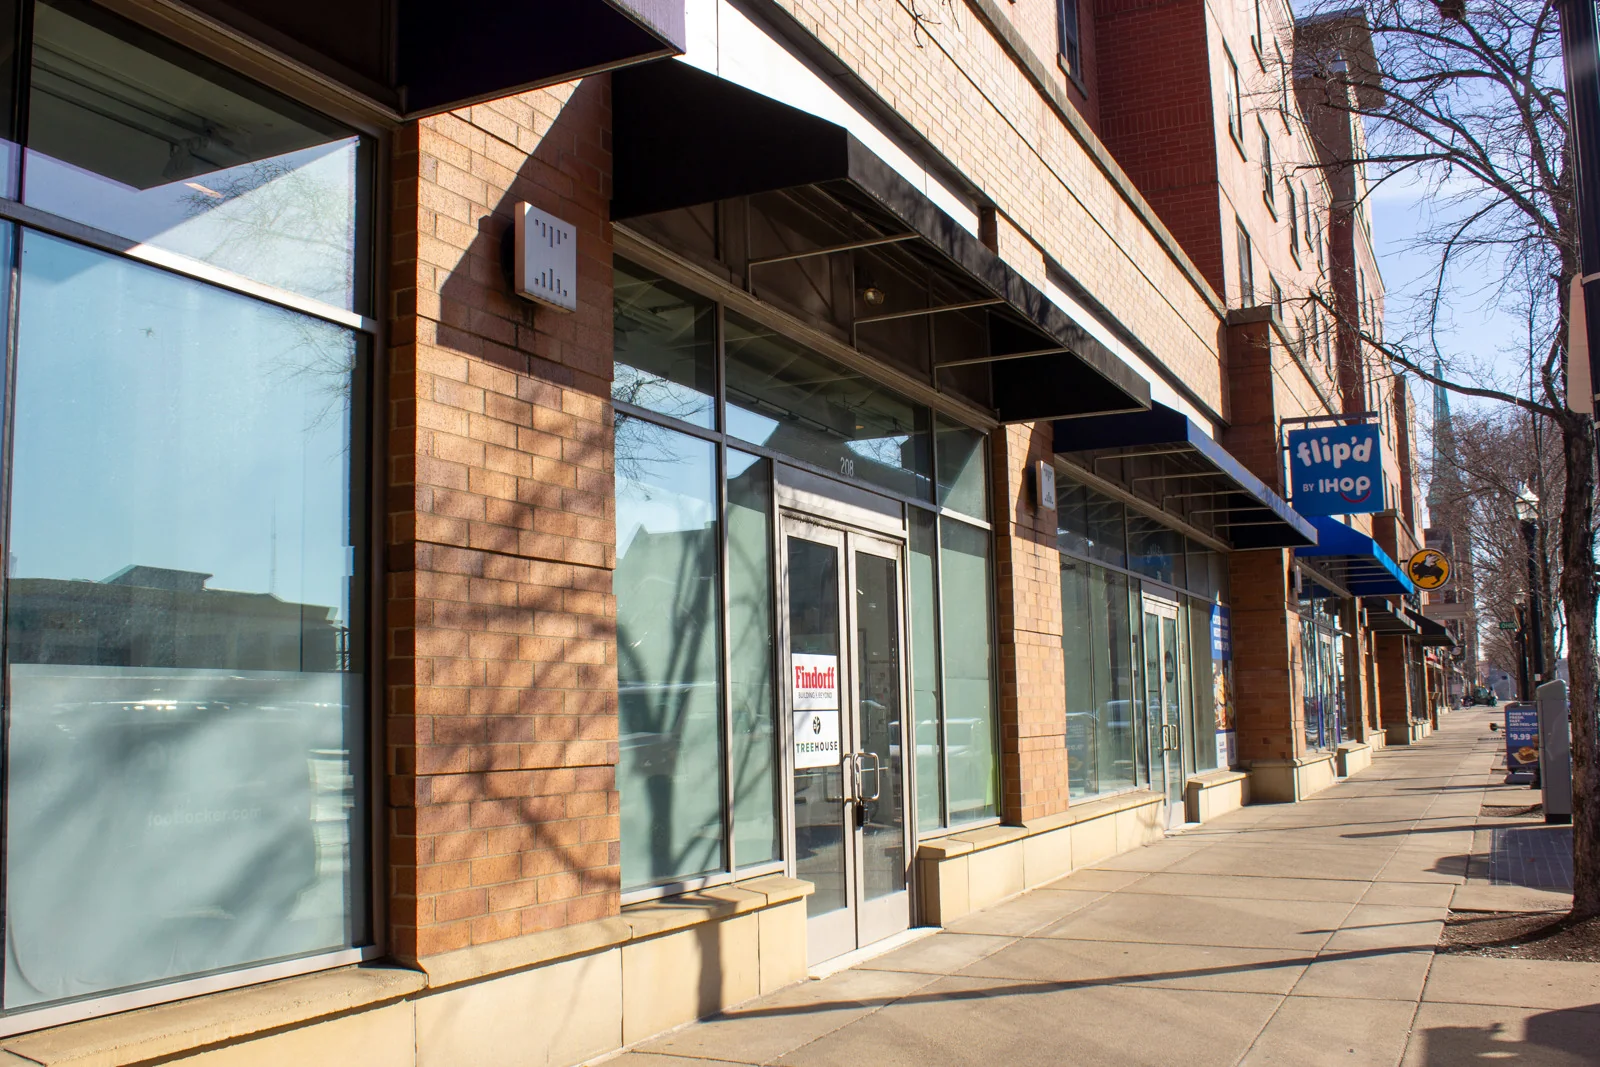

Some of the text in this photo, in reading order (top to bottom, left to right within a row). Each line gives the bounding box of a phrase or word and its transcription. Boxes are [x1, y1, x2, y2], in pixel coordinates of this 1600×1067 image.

[1297, 436, 1373, 469] flip'd
[840, 457, 854, 477] 208
[1302, 476, 1371, 496] BY IHOP
[795, 666, 835, 689] Findorff
[798, 691, 815, 699] BUILDING
[796, 741, 838, 753] TREEHOUSE
[147, 807, 262, 827] footlocker.com
